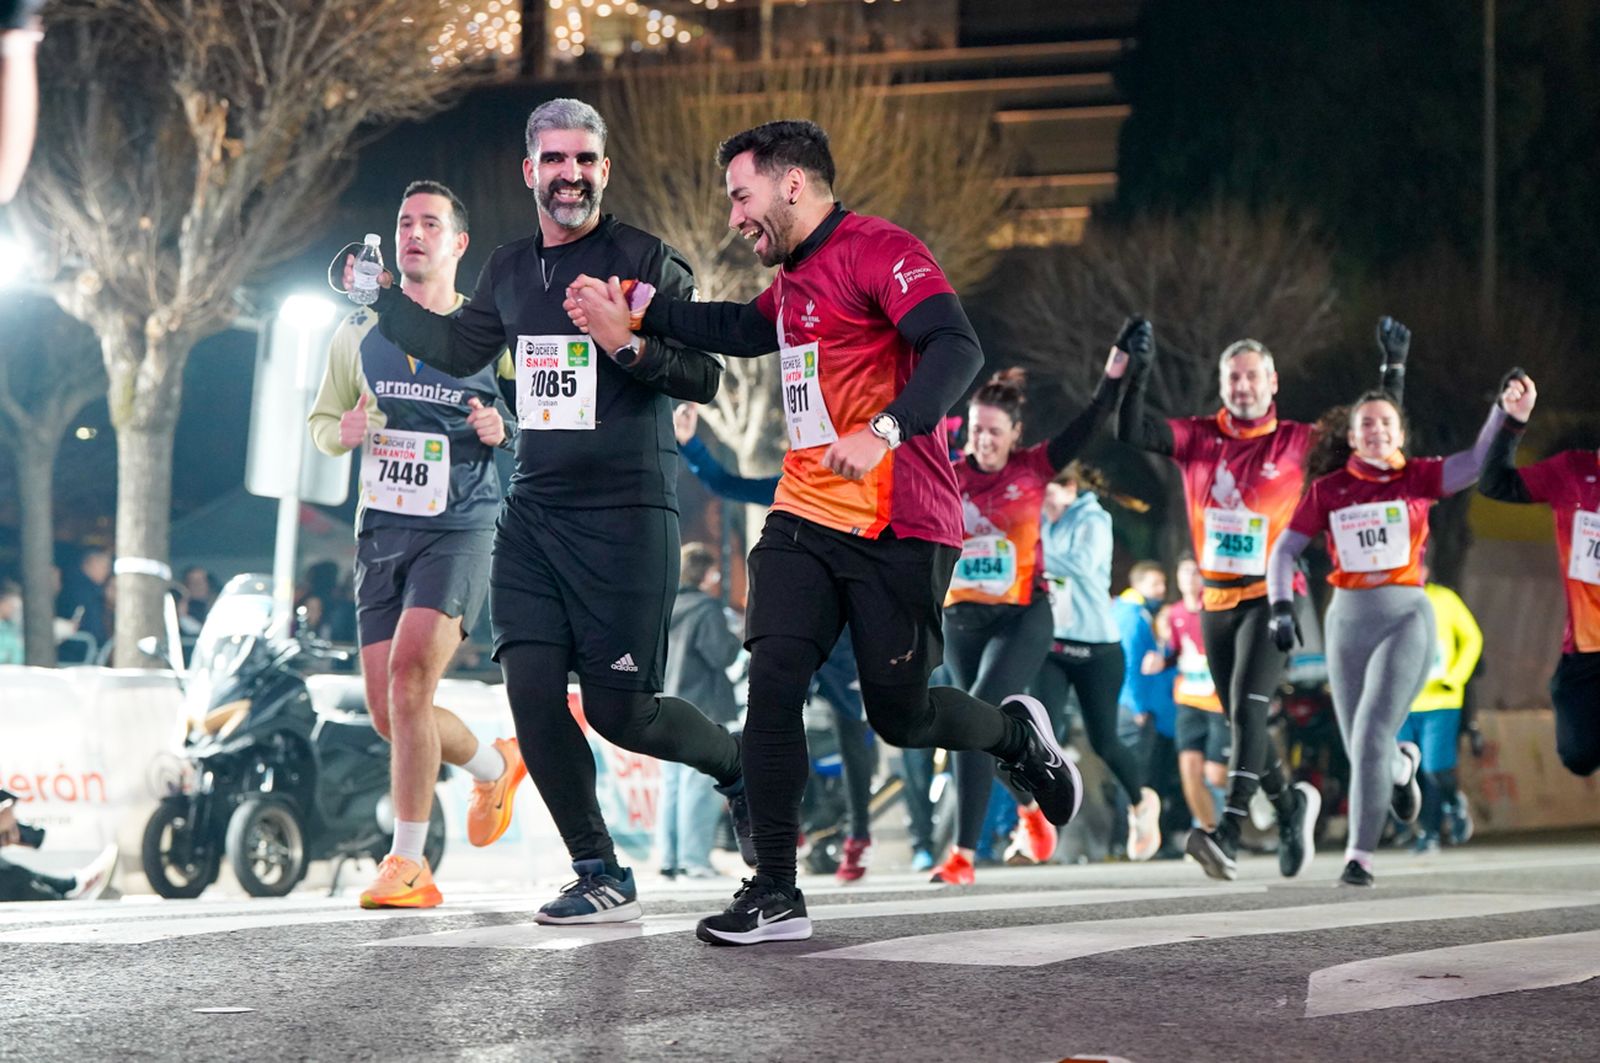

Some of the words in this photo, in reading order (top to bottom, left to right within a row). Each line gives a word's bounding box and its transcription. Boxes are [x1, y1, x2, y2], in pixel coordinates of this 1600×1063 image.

[375, 380, 463, 404] armoniza
[530, 370, 577, 398] 1085
[372, 447, 387, 457] SAN
[406, 440, 416, 450] DE
[379, 459, 429, 487] 7448
[1356, 527, 1388, 549] 104
[610, 664, 639, 672] adidas
[0, 763, 107, 803] erón
